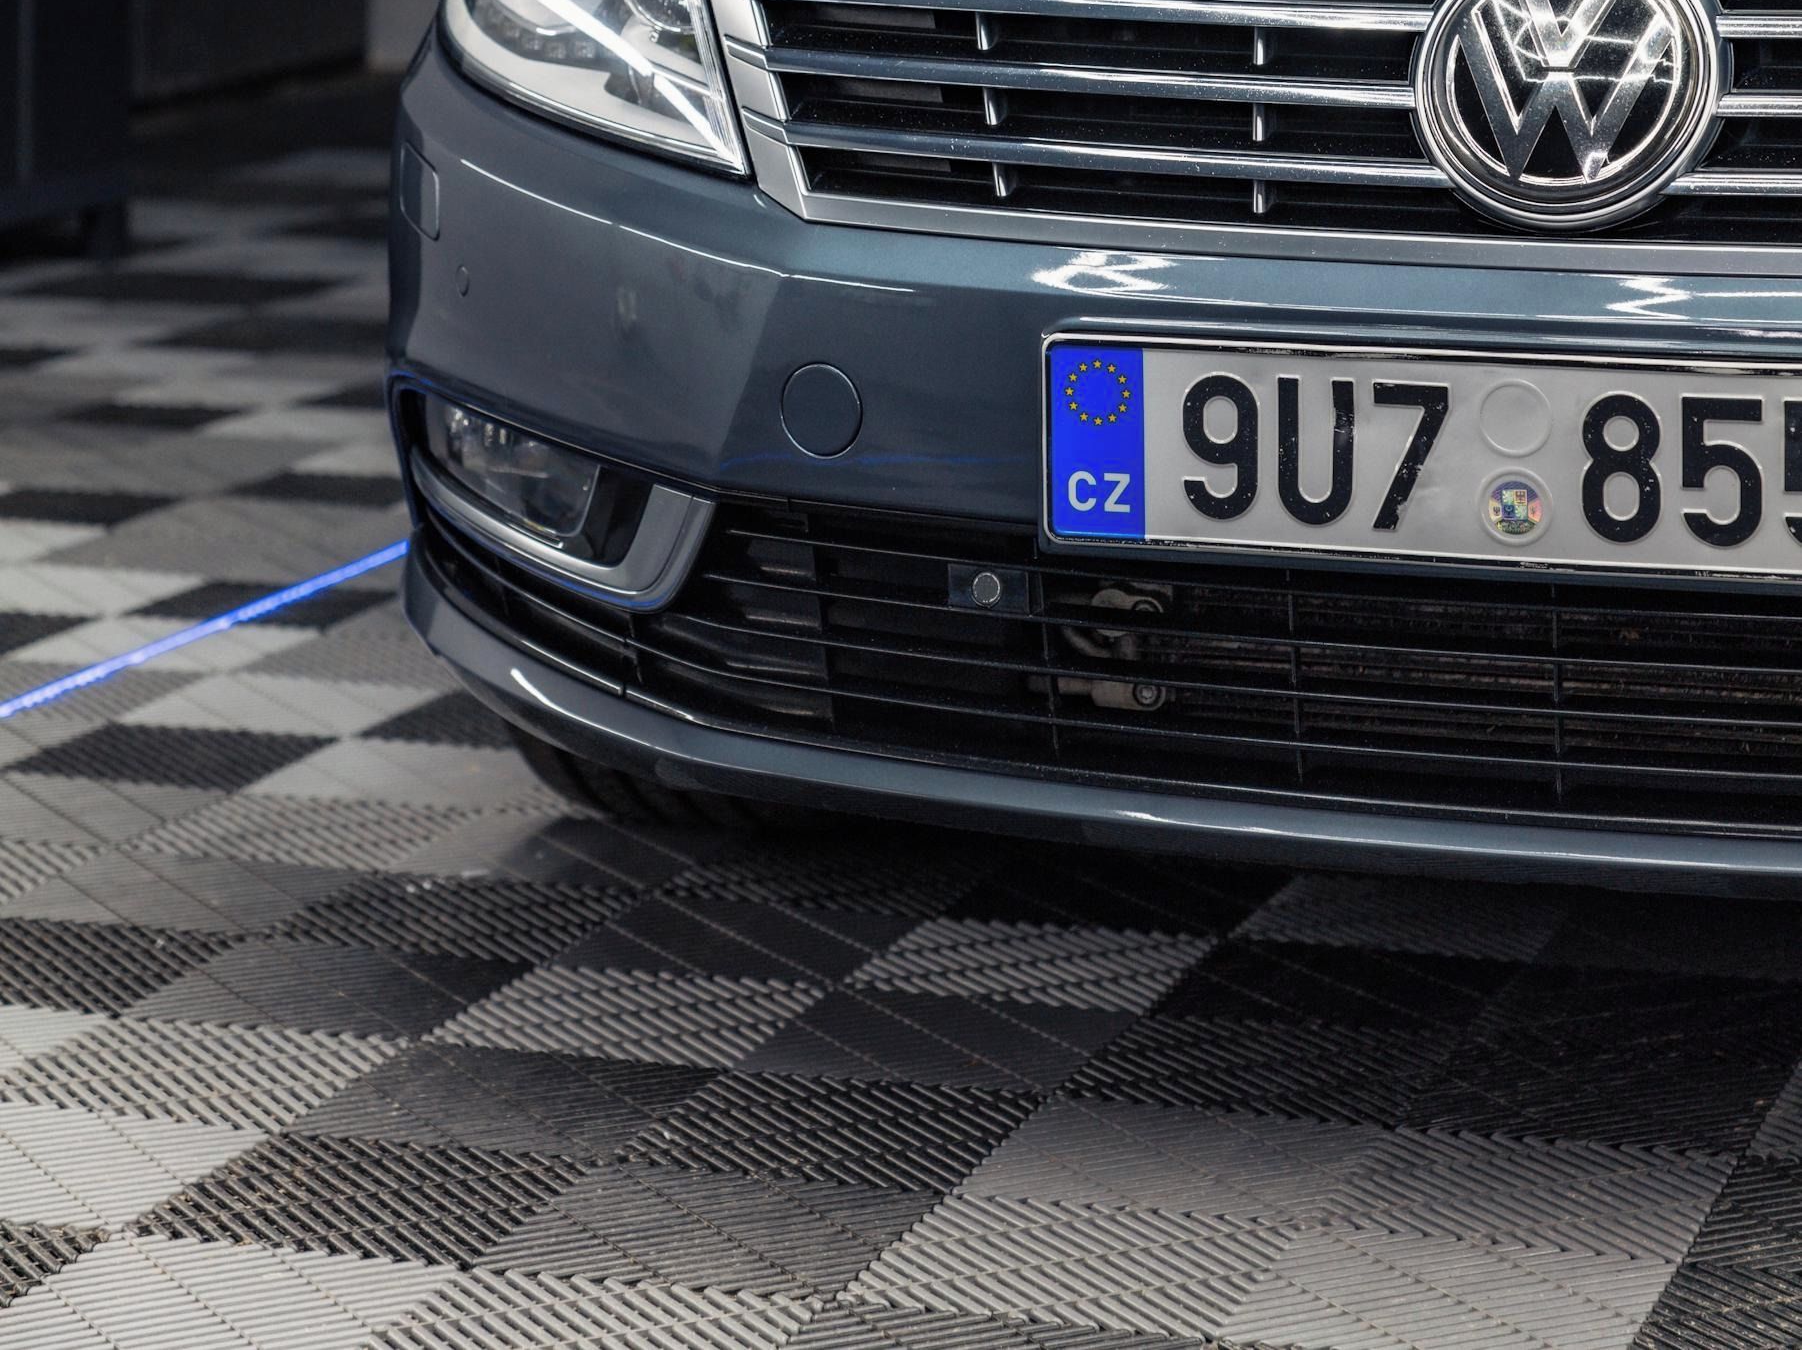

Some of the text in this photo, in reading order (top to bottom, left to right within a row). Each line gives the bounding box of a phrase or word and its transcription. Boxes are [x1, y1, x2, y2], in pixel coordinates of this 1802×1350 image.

[1067, 470, 1131, 513] CZ
[1182, 372, 1802, 548] 9U7 85
